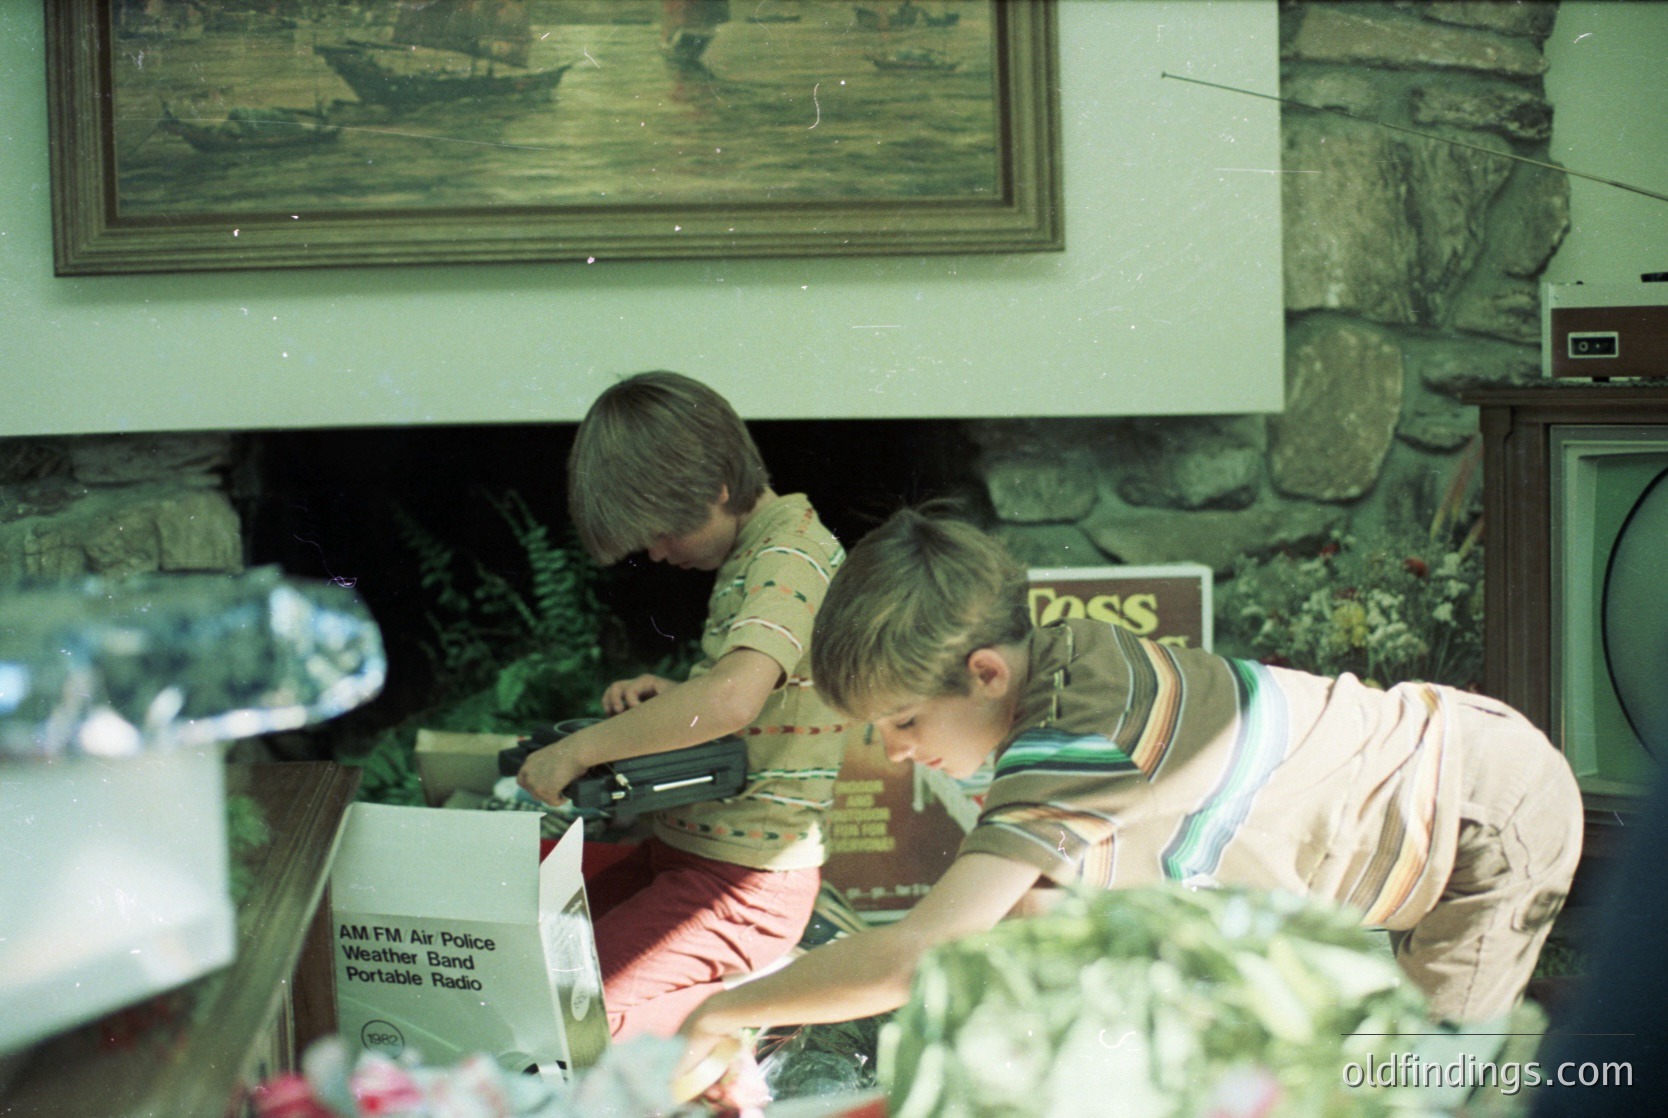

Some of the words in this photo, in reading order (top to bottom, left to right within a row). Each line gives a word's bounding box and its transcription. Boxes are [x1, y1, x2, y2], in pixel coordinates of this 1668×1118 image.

[342, 945, 418, 965] Weather
[427, 951, 475, 970] Band
[345, 966, 423, 986] Portable
[431, 972, 483, 992] Radio
